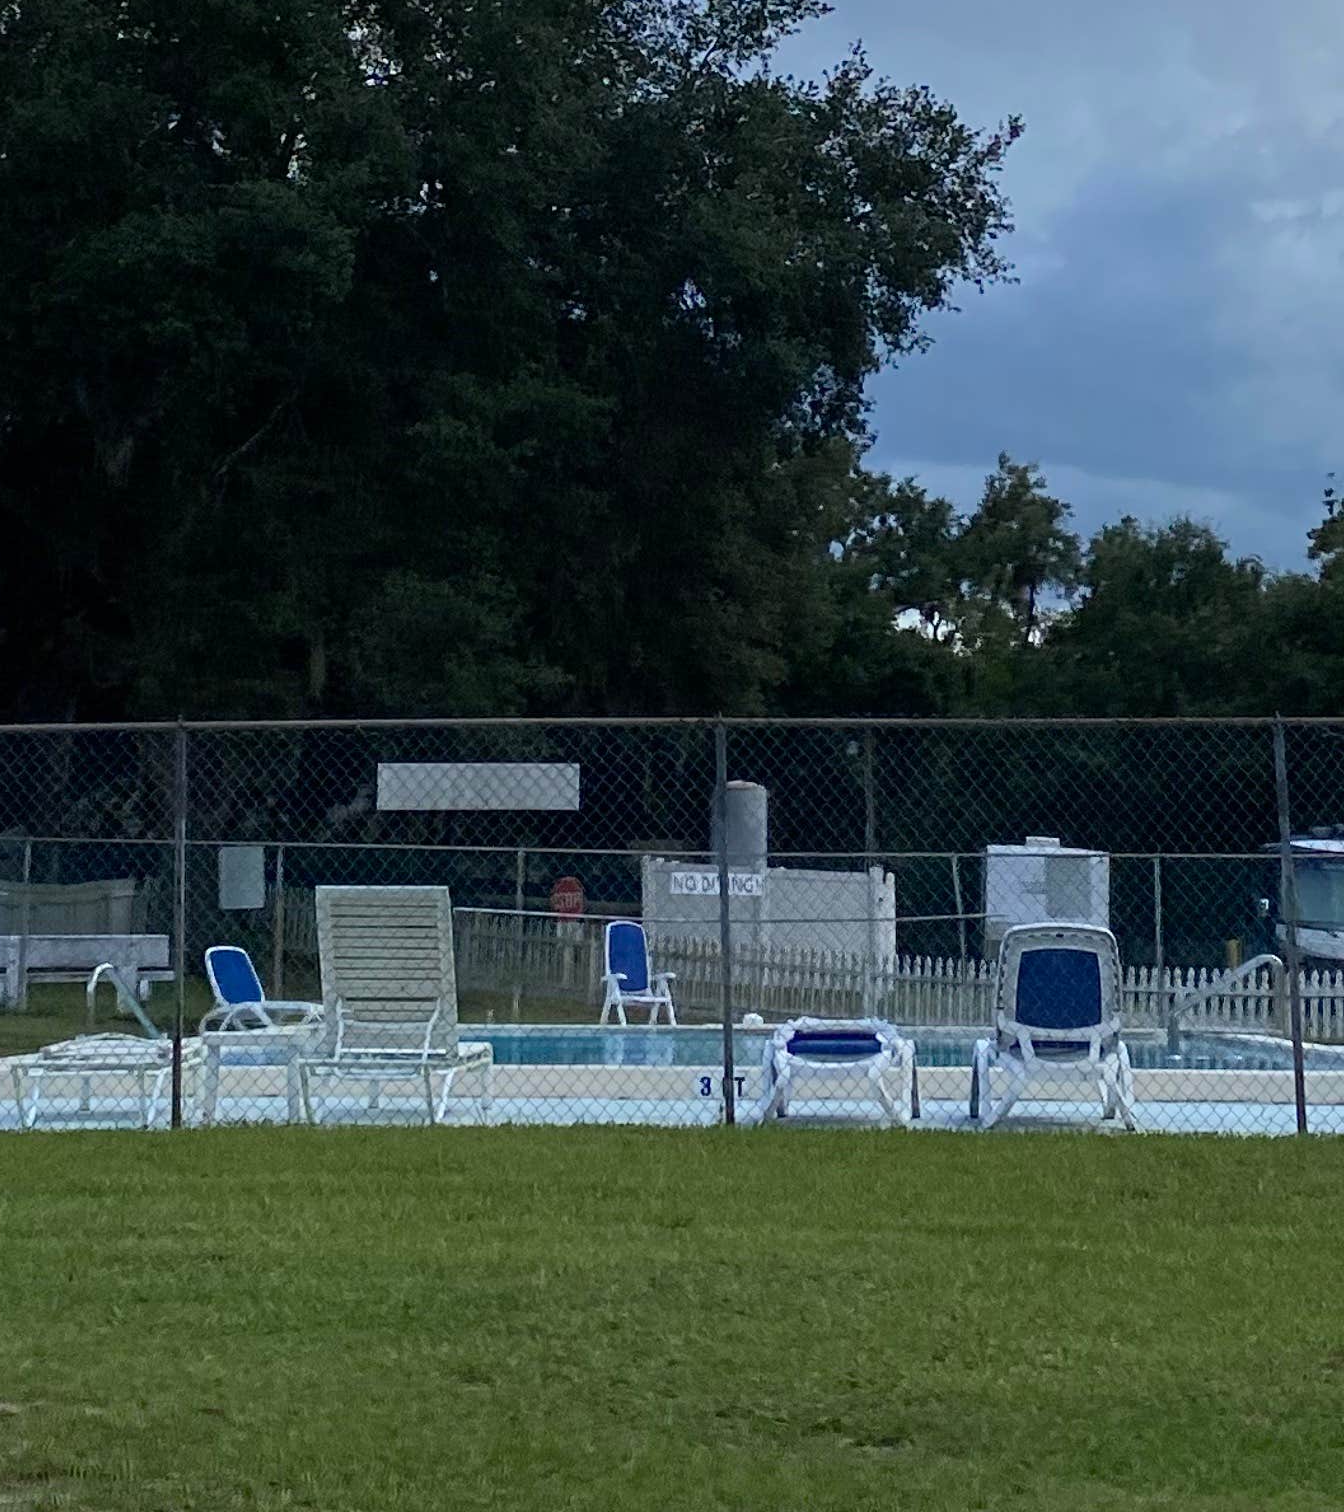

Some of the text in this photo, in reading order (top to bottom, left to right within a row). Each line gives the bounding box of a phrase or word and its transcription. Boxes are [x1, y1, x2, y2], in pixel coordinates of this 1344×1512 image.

[673, 875, 753, 893] NO DIING
[700, 1076, 711, 1097] 3
